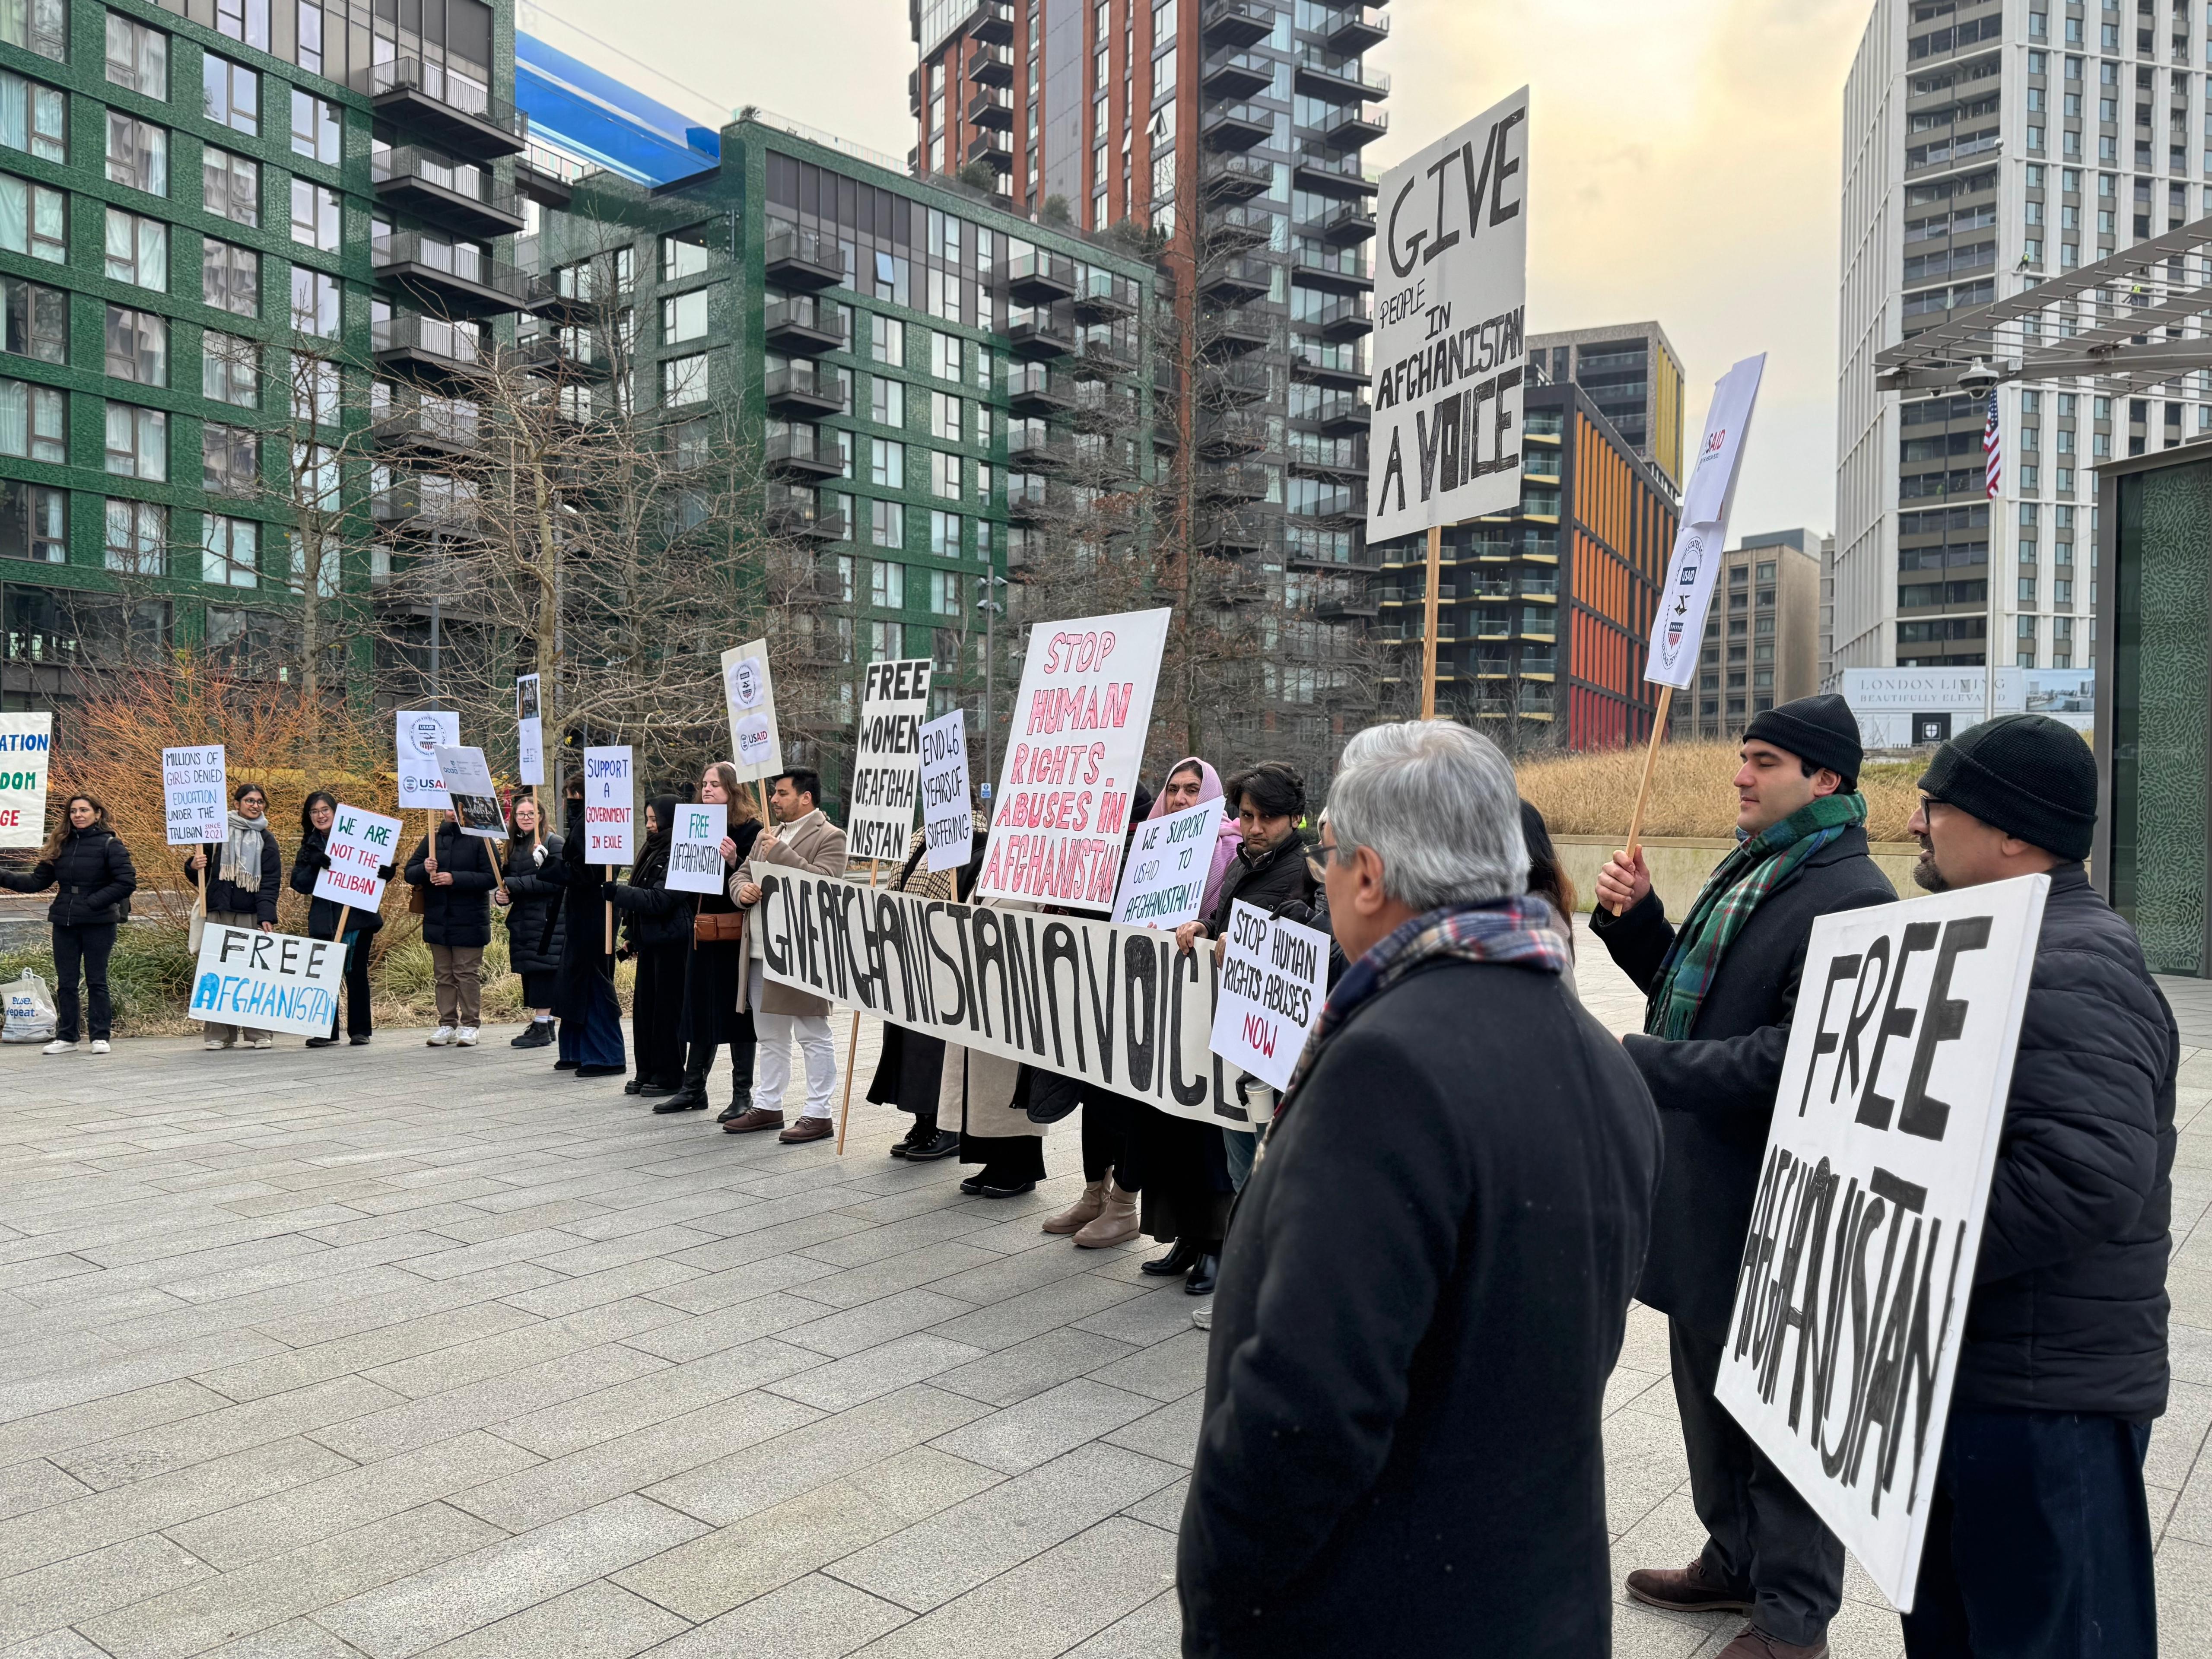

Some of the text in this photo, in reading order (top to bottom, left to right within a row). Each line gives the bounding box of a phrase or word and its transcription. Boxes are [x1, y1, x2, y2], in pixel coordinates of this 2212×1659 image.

[1388, 105, 1526, 278] GIVE
[1380, 278, 1425, 329] PEOPLE
[1425, 301, 1451, 341] IN
[1375, 305, 1525, 412] AFGHANISTAN
[1377, 365, 1522, 517] A VOICE
[1044, 631, 1116, 674] STOP
[864, 661, 931, 702] FREE
[1861, 679, 1934, 690] LONDON
[1026, 683, 1133, 736] HUMAN
[0, 734, 49, 752] ATION
[748, 731, 768, 744] USAID
[860, 714, 924, 754] WOMEN
[922, 723, 959, 767] END 46
[166, 752, 219, 766] MILLIONS OF
[166, 769, 222, 786] GIRLS DENIED
[588, 758, 629, 778] SUPPORT
[0, 772, 36, 790] DOM
[173, 789, 217, 806] EDUCATION
[420, 779, 446, 788] USAI
[604, 782, 610, 798] A
[924, 766, 963, 809] YEARS OF
[167, 806, 215, 821] UNDER THE
[585, 806, 631, 823] GOVERNMENT
[689, 813, 709, 839] FREE
[995, 791, 1092, 832] ABUSES
[1141, 809, 1210, 851] WE SUPPORT
[168, 826, 203, 840] TALIBAN
[205, 830, 223, 839] 2021
[338, 815, 392, 847] WE ARE
[592, 835, 622, 849] IN EXILE
[850, 818, 905, 859] NISTAN
[928, 813, 969, 850] SUFFERING
[330, 842, 380, 869] NOT THE
[672, 842, 722, 876] AFGHANISTAN
[981, 834, 1121, 903] AFGHANISTAN
[1133, 847, 1193, 884] USAID TO
[327, 869, 376, 896] TALIBAN
[219, 929, 328, 979] FREE
[1233, 908, 1317, 985] STOP HUMAN
[1223, 957, 1312, 1028] RIGHTS ABUSES
[1242, 1011, 1278, 1059] NOW
[1799, 915, 1994, 1142] FREE
